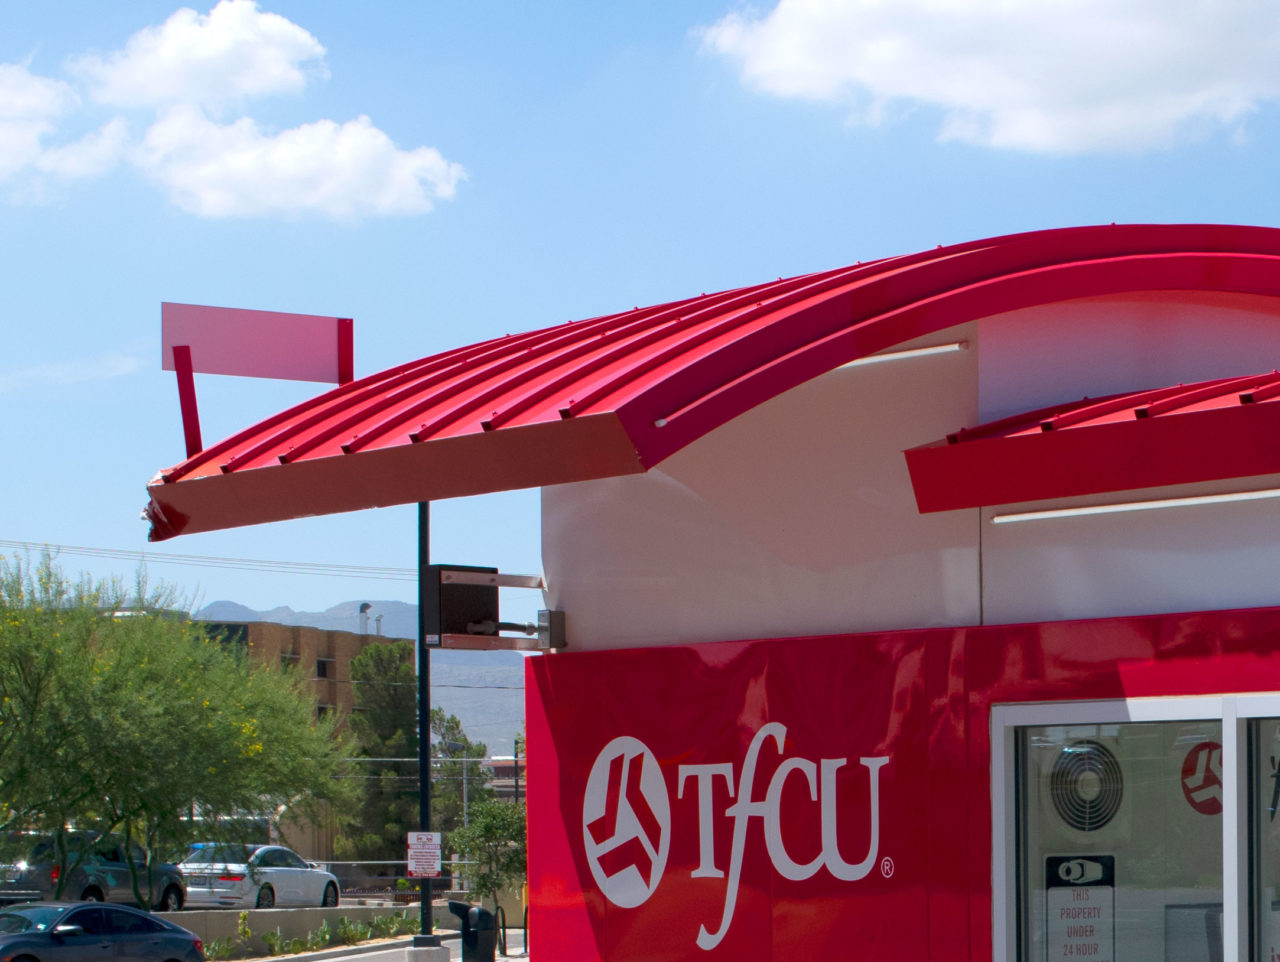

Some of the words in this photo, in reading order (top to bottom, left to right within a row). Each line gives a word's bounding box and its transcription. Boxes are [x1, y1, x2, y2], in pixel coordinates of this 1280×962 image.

[1072, 887, 1090, 902] THIS
[1060, 906, 1102, 920] PROPERTY
[1067, 925, 1095, 938] UNDER
[1063, 944, 1073, 956] 24
[1076, 943, 1099, 956] HOUR
